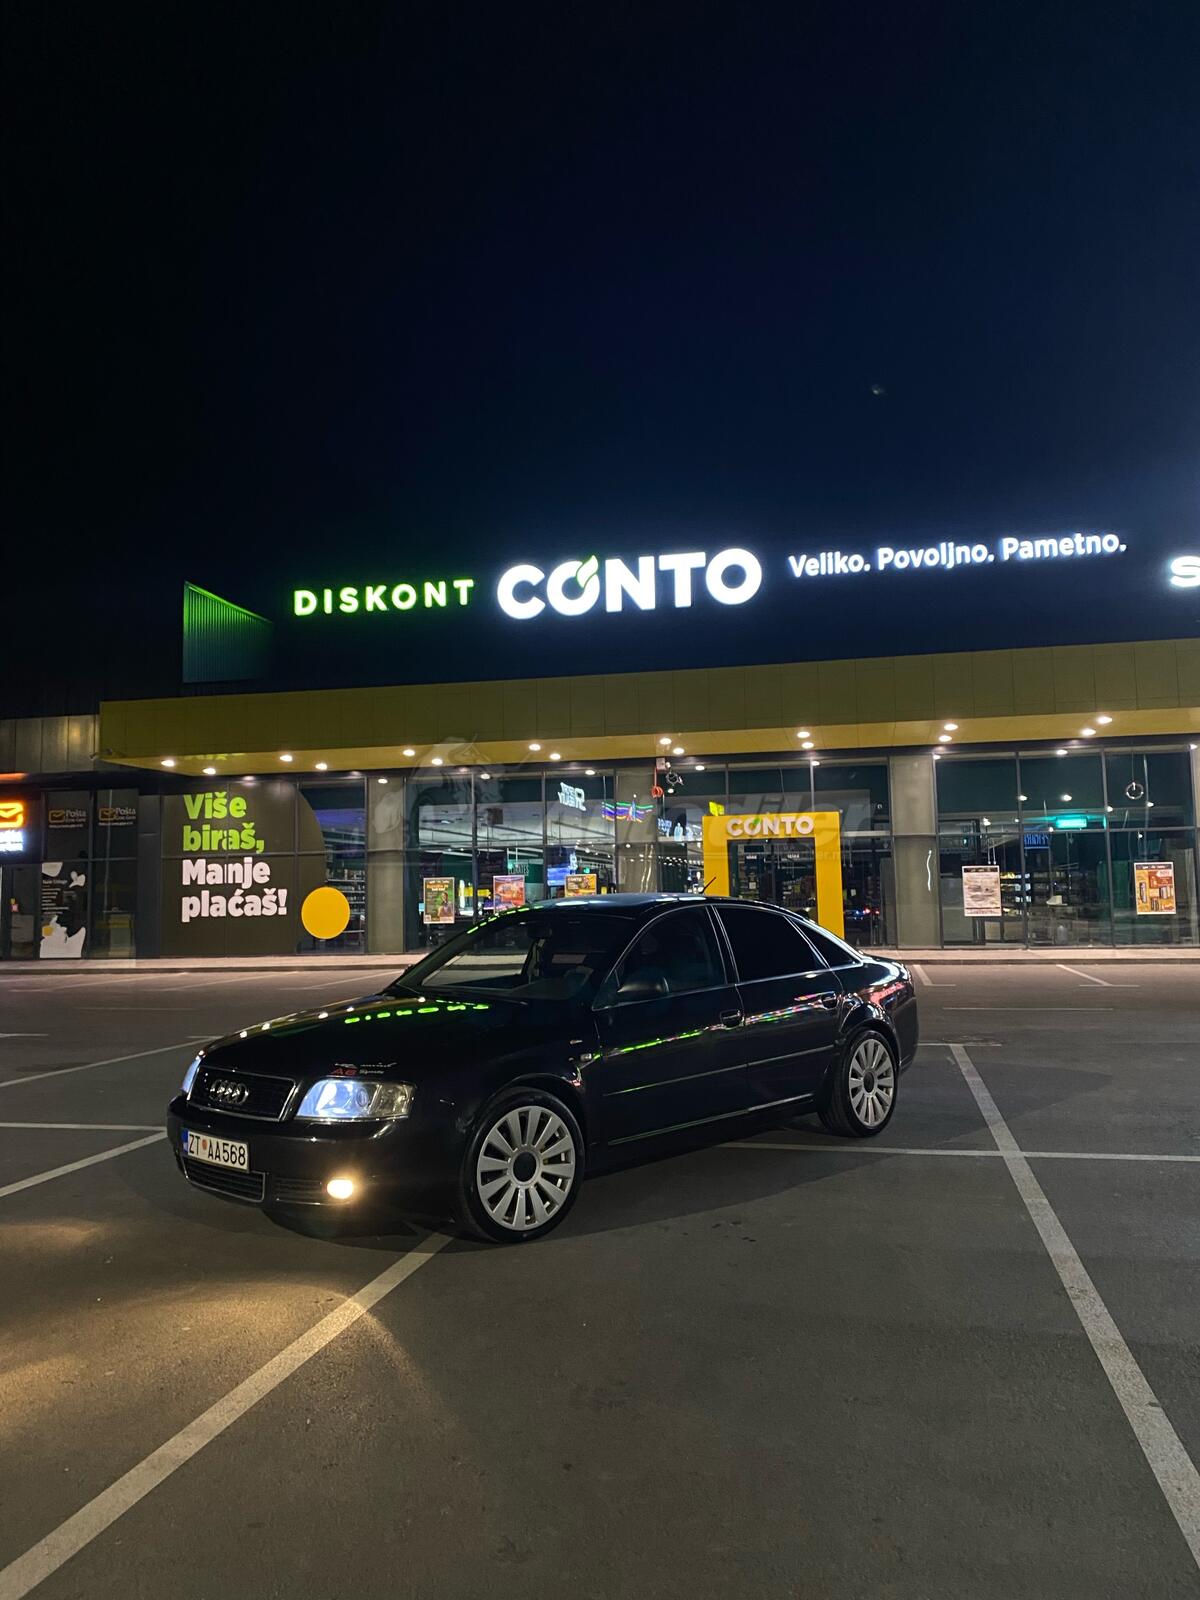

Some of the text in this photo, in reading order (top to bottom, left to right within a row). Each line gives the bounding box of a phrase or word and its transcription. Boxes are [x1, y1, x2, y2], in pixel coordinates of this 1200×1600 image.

[789, 533, 1126, 578] Veliko. Povoljno. Pametno.
[294, 580, 474, 616] DISKONT
[497, 548, 763, 619] CONTO
[183, 791, 247, 820] Više
[182, 822, 265, 854] biraš,
[727, 816, 815, 837] CONTO
[182, 856, 271, 889] Manje
[181, 888, 288, 923] plaćaš!
[189, 1134, 246, 1166] ZT AA568
